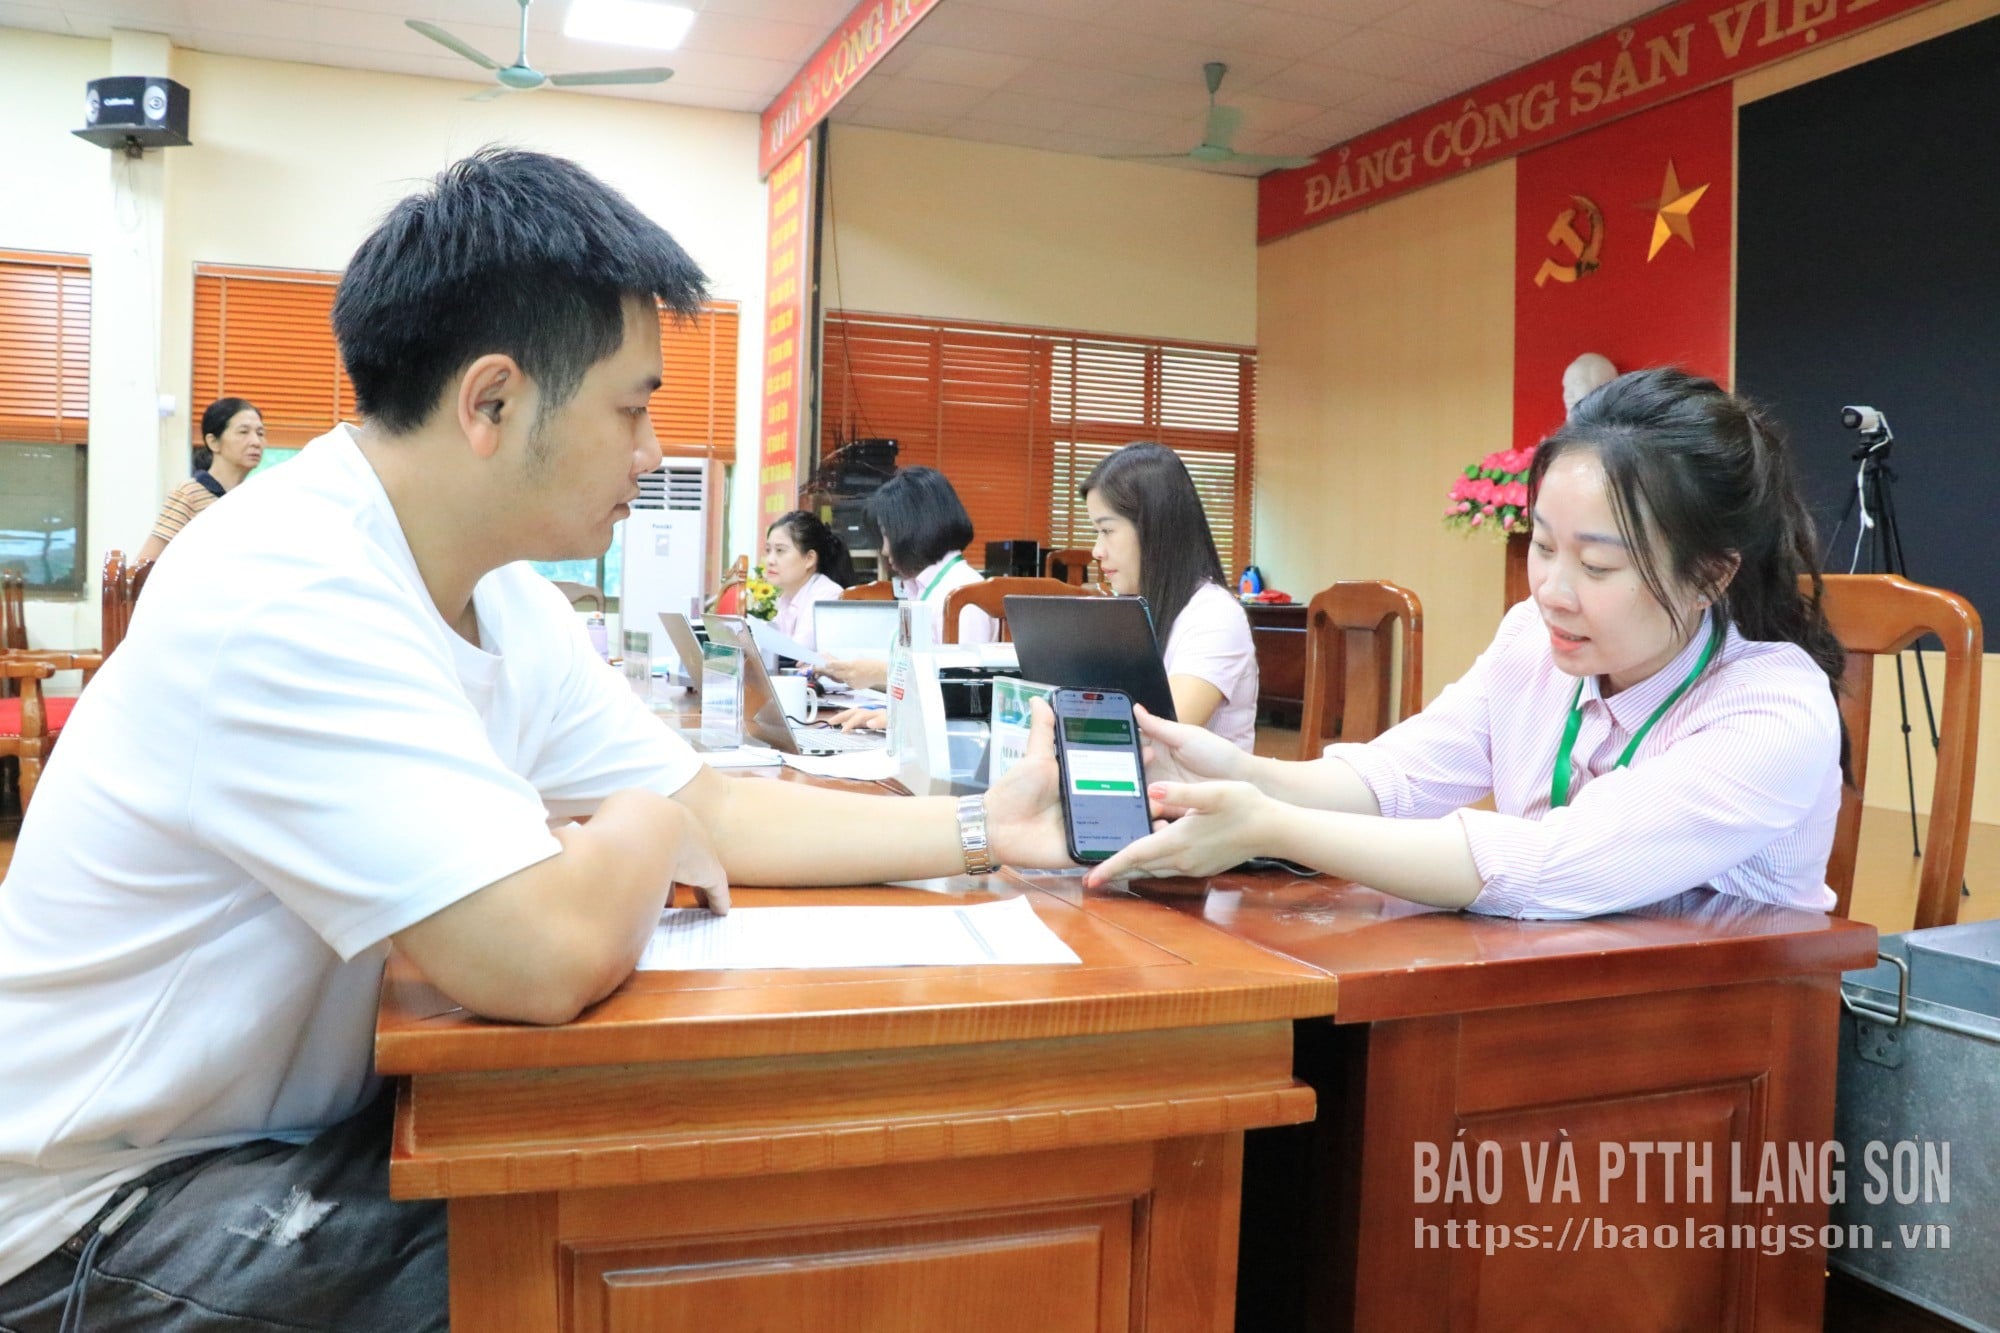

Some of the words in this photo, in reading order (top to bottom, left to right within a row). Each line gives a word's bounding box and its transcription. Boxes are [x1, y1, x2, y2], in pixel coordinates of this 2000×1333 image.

[1304, 138, 1416, 214] ĐẢNG
[1422, 81, 1560, 168] CỘNG
[1570, 24, 1695, 116] SẢN
